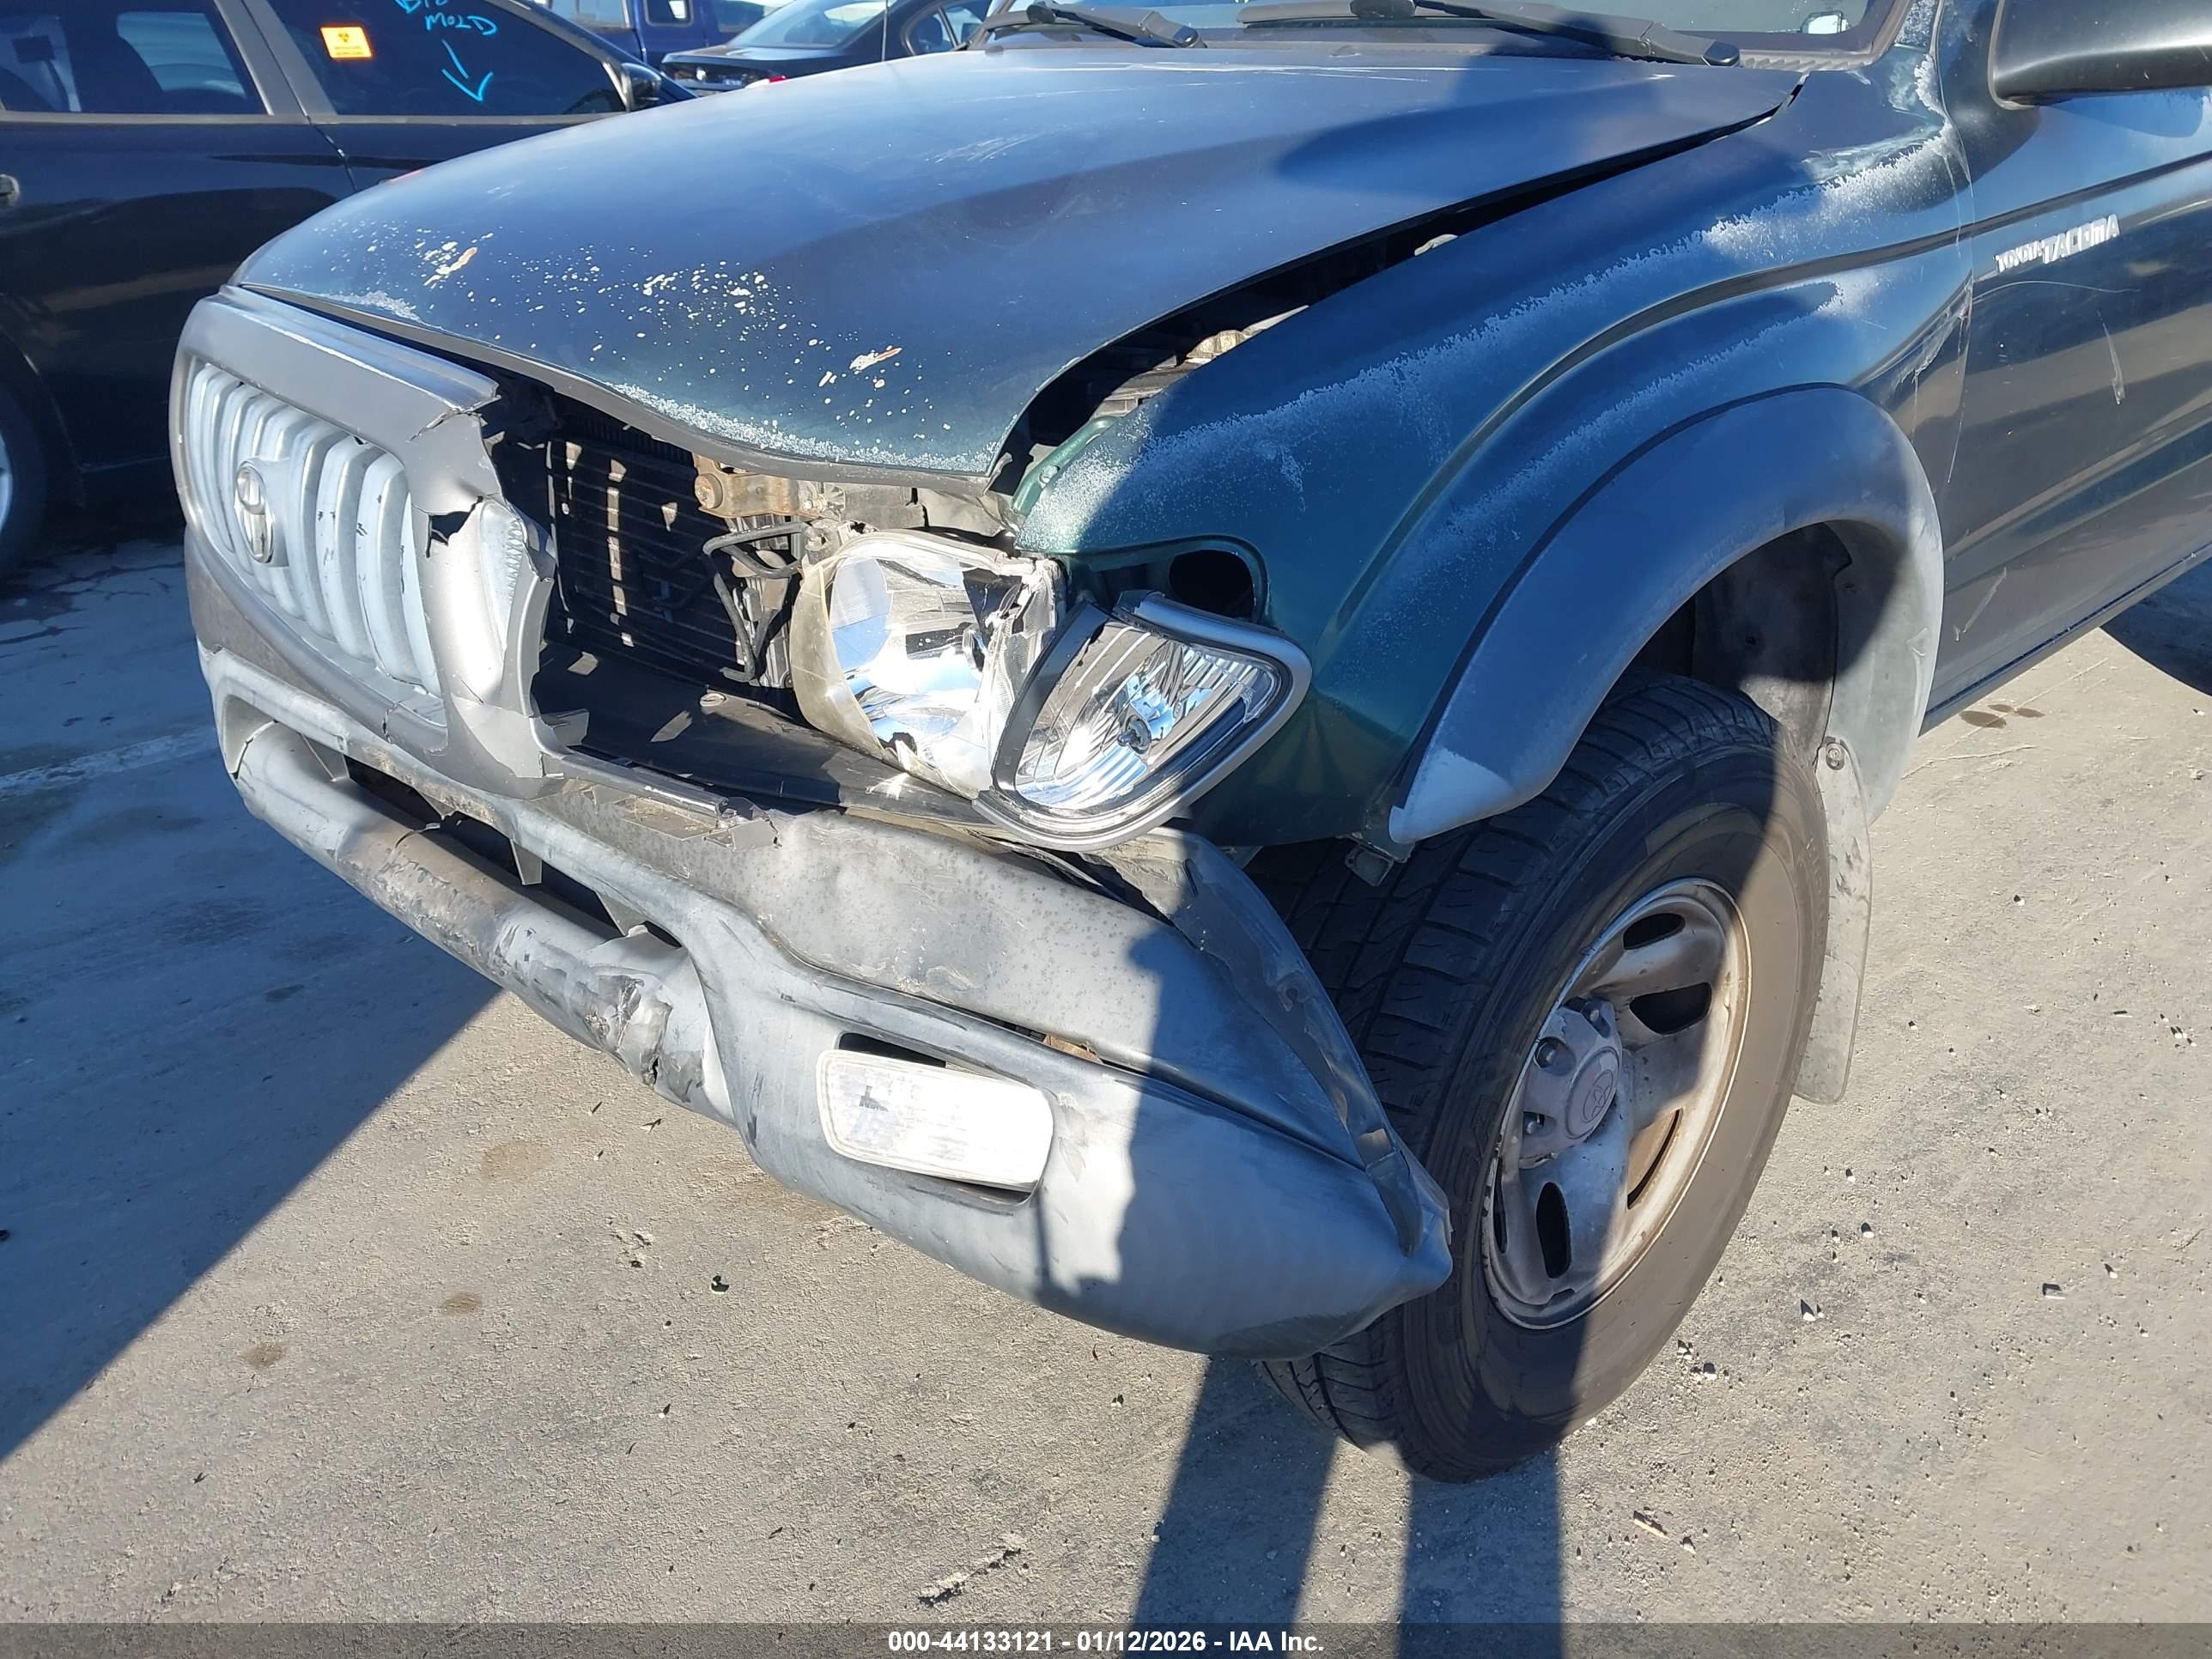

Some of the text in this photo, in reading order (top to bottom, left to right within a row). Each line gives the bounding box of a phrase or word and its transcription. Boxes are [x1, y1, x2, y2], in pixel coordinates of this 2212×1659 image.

[425, 12, 497, 35] MOLD
[1994, 214, 2120, 273] TOYOTA TACOMA
